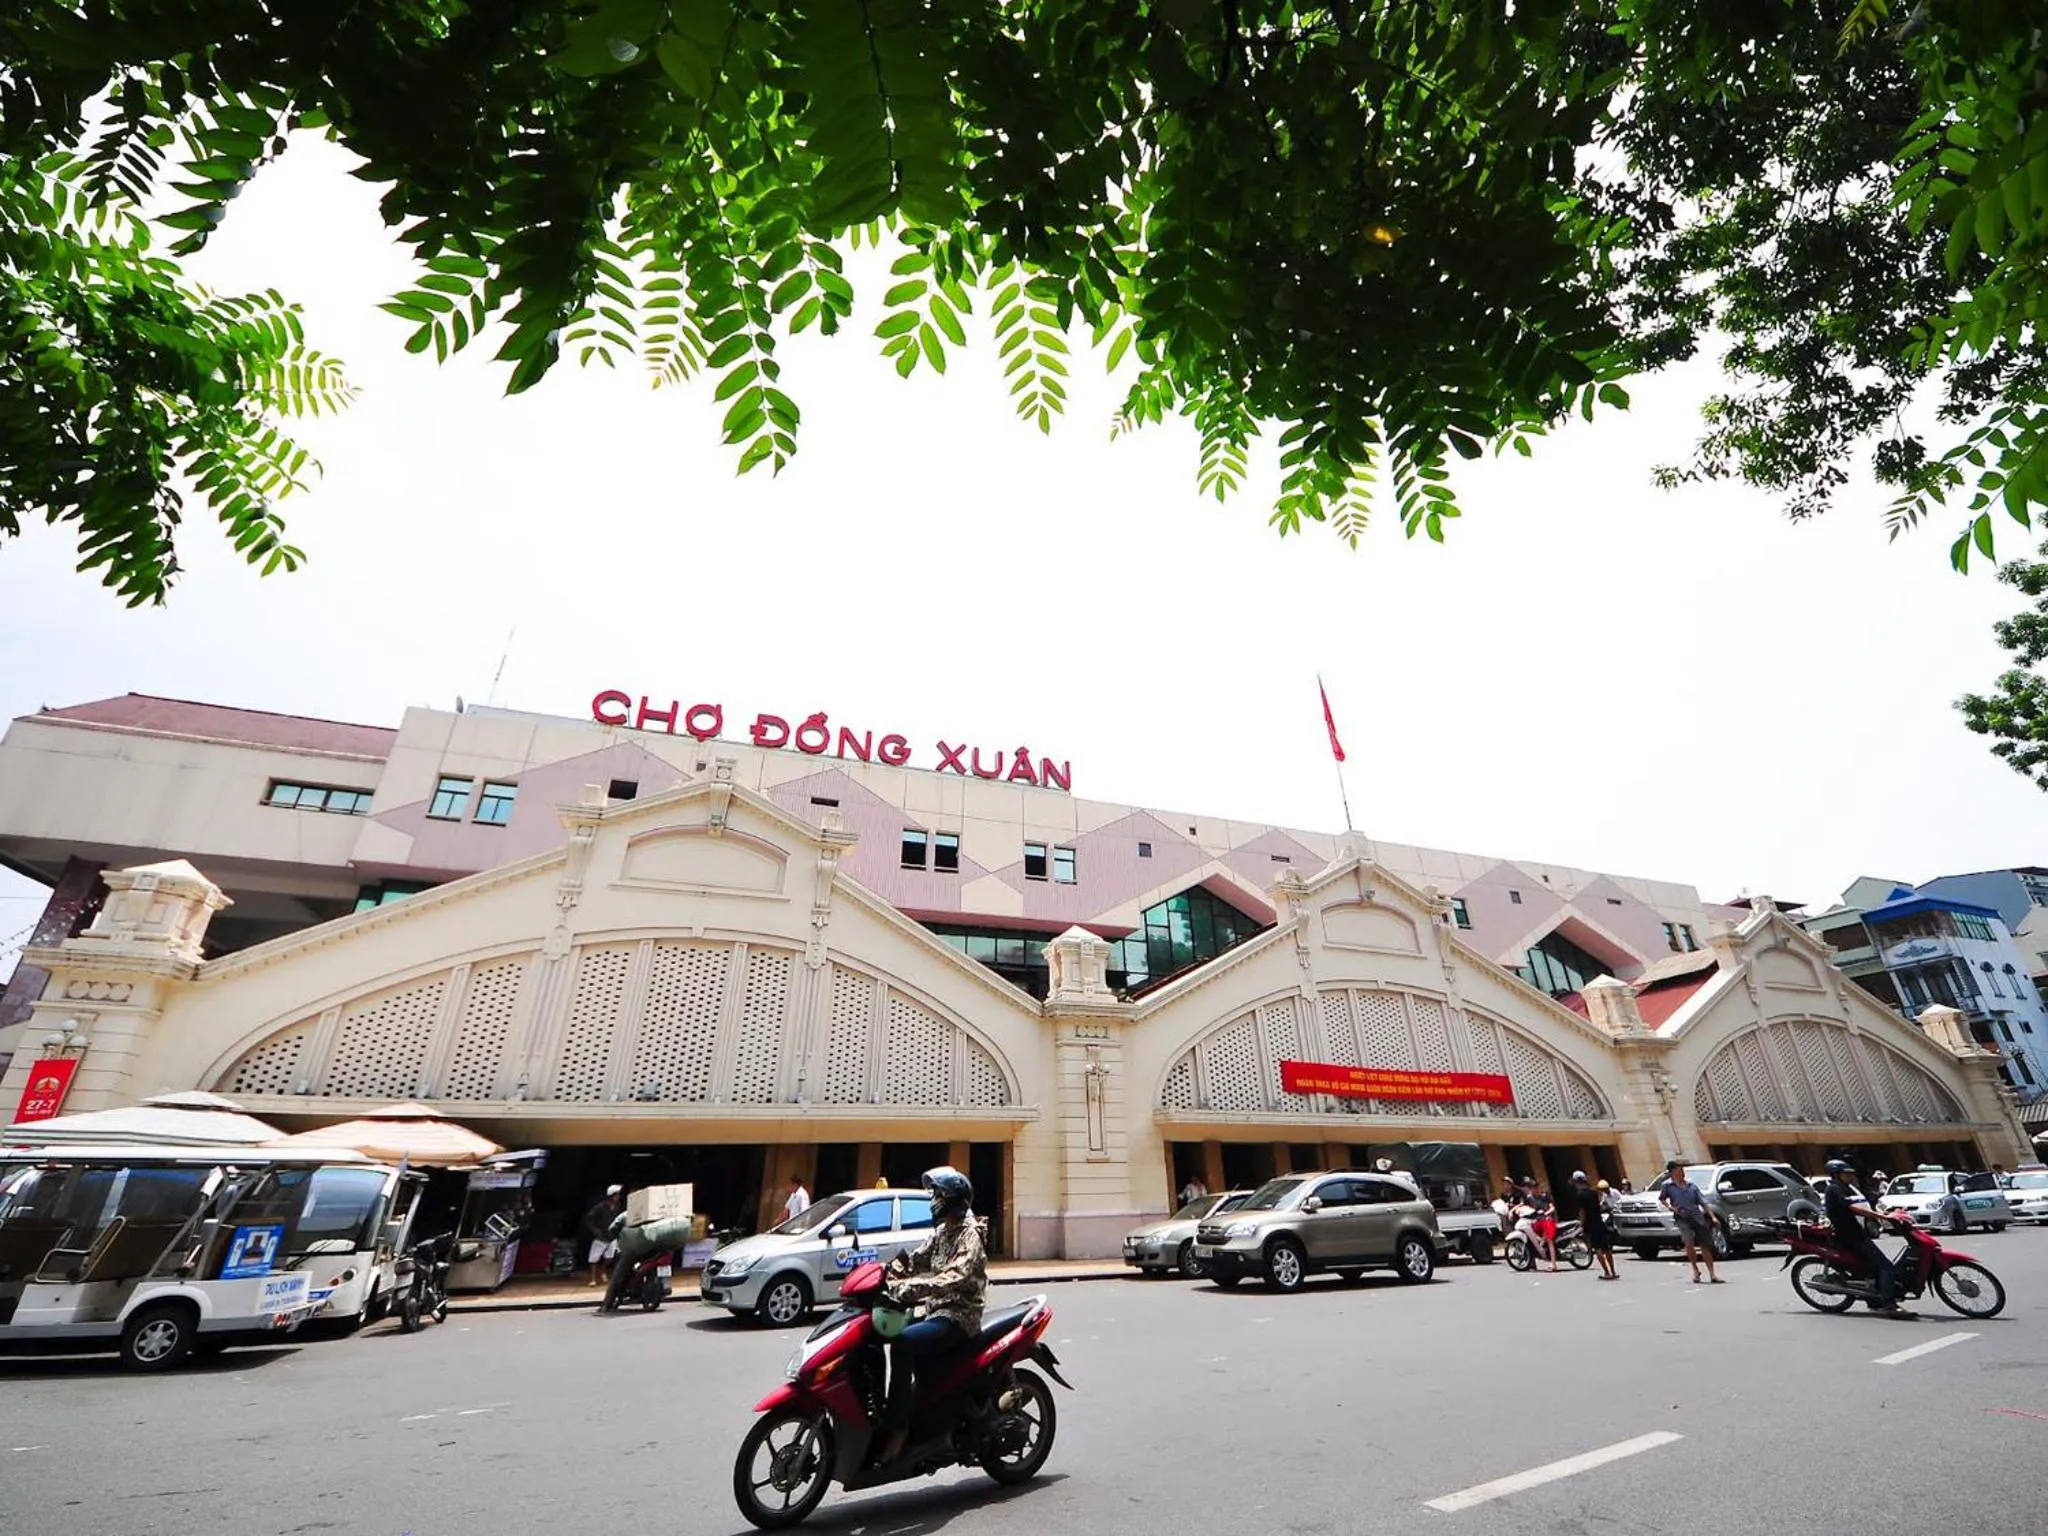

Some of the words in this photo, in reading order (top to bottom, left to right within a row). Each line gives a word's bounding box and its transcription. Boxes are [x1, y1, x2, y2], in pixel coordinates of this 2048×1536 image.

[591, 689, 724, 742] CHỢ
[750, 711, 912, 767] ĐỒNG
[937, 741, 1072, 790] XUÂN
[27, 1099, 56, 1110] 27-7
